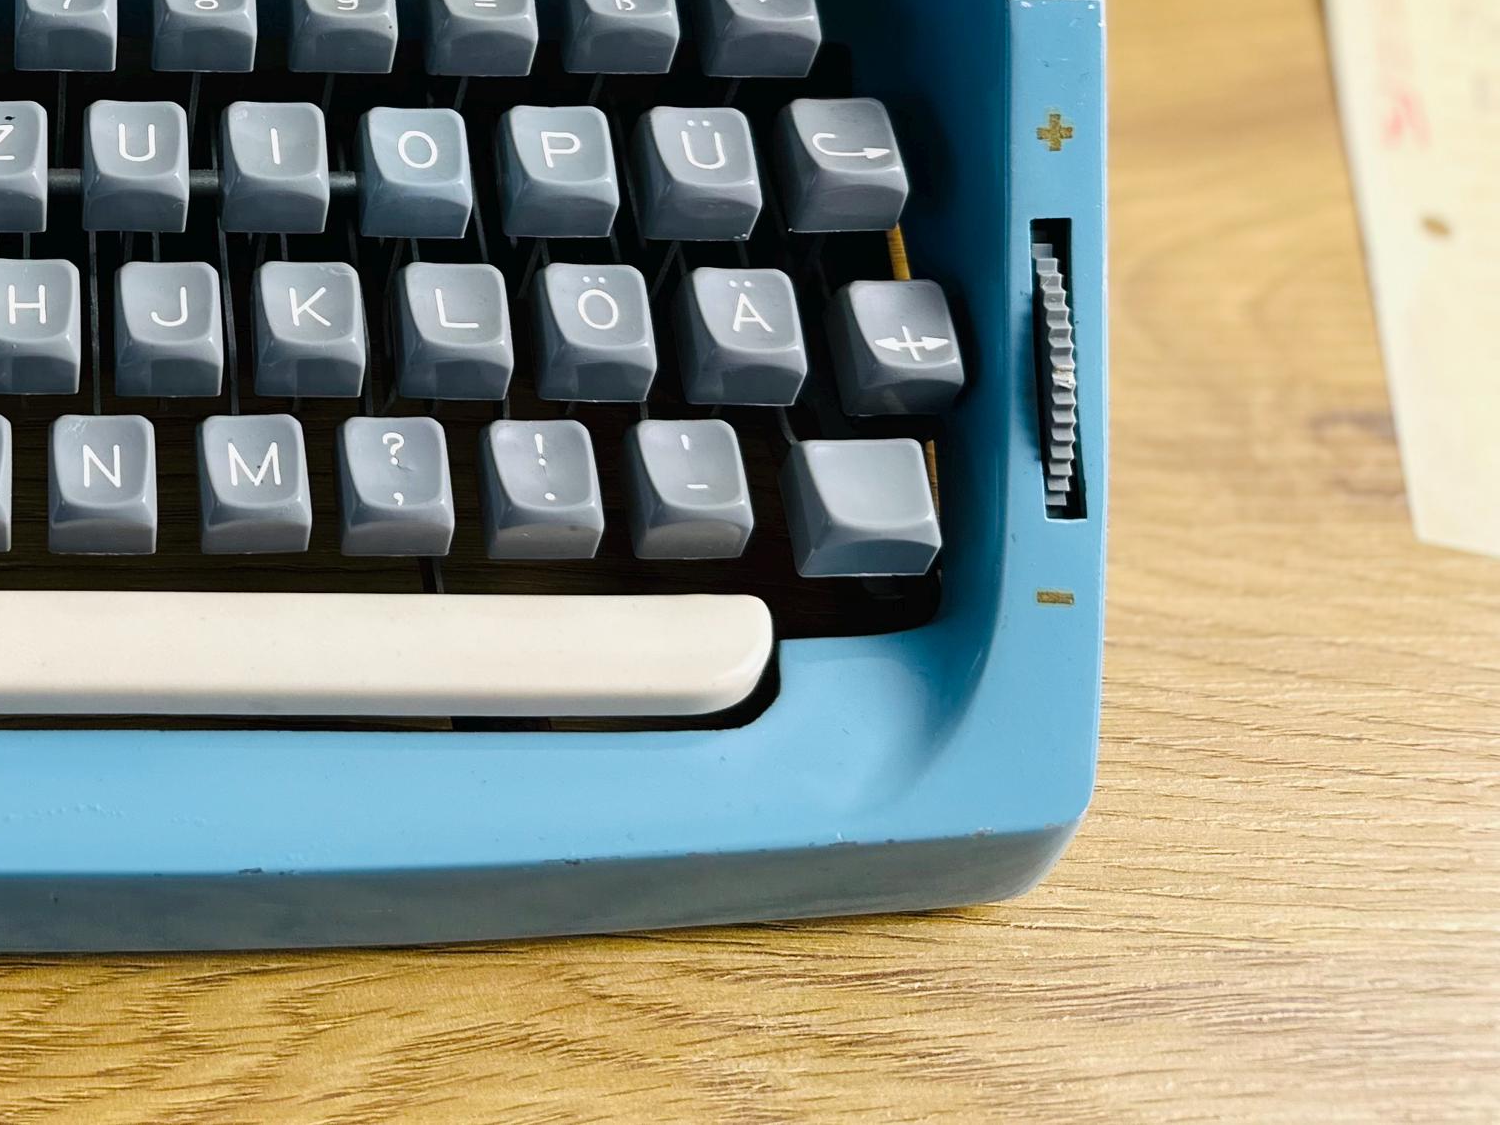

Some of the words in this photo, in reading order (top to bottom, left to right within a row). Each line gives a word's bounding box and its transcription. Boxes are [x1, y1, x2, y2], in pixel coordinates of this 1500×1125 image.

[118, 123, 156, 162] U
[270, 128, 281, 164] I
[398, 131, 438, 168] O
[540, 131, 581, 168] P
[681, 120, 725, 170] Ü
[8, 284, 47, 324] H
[151, 287, 188, 327] J
[288, 286, 331, 327] K
[435, 288, 479, 329] L
[577, 276, 619, 331] Ö
[727, 281, 772, 332] Ä
[82, 444, 121, 487] N
[227, 442, 282, 487] M
[382, 432, 405, 466] ?
[534, 434, 547, 466] !
